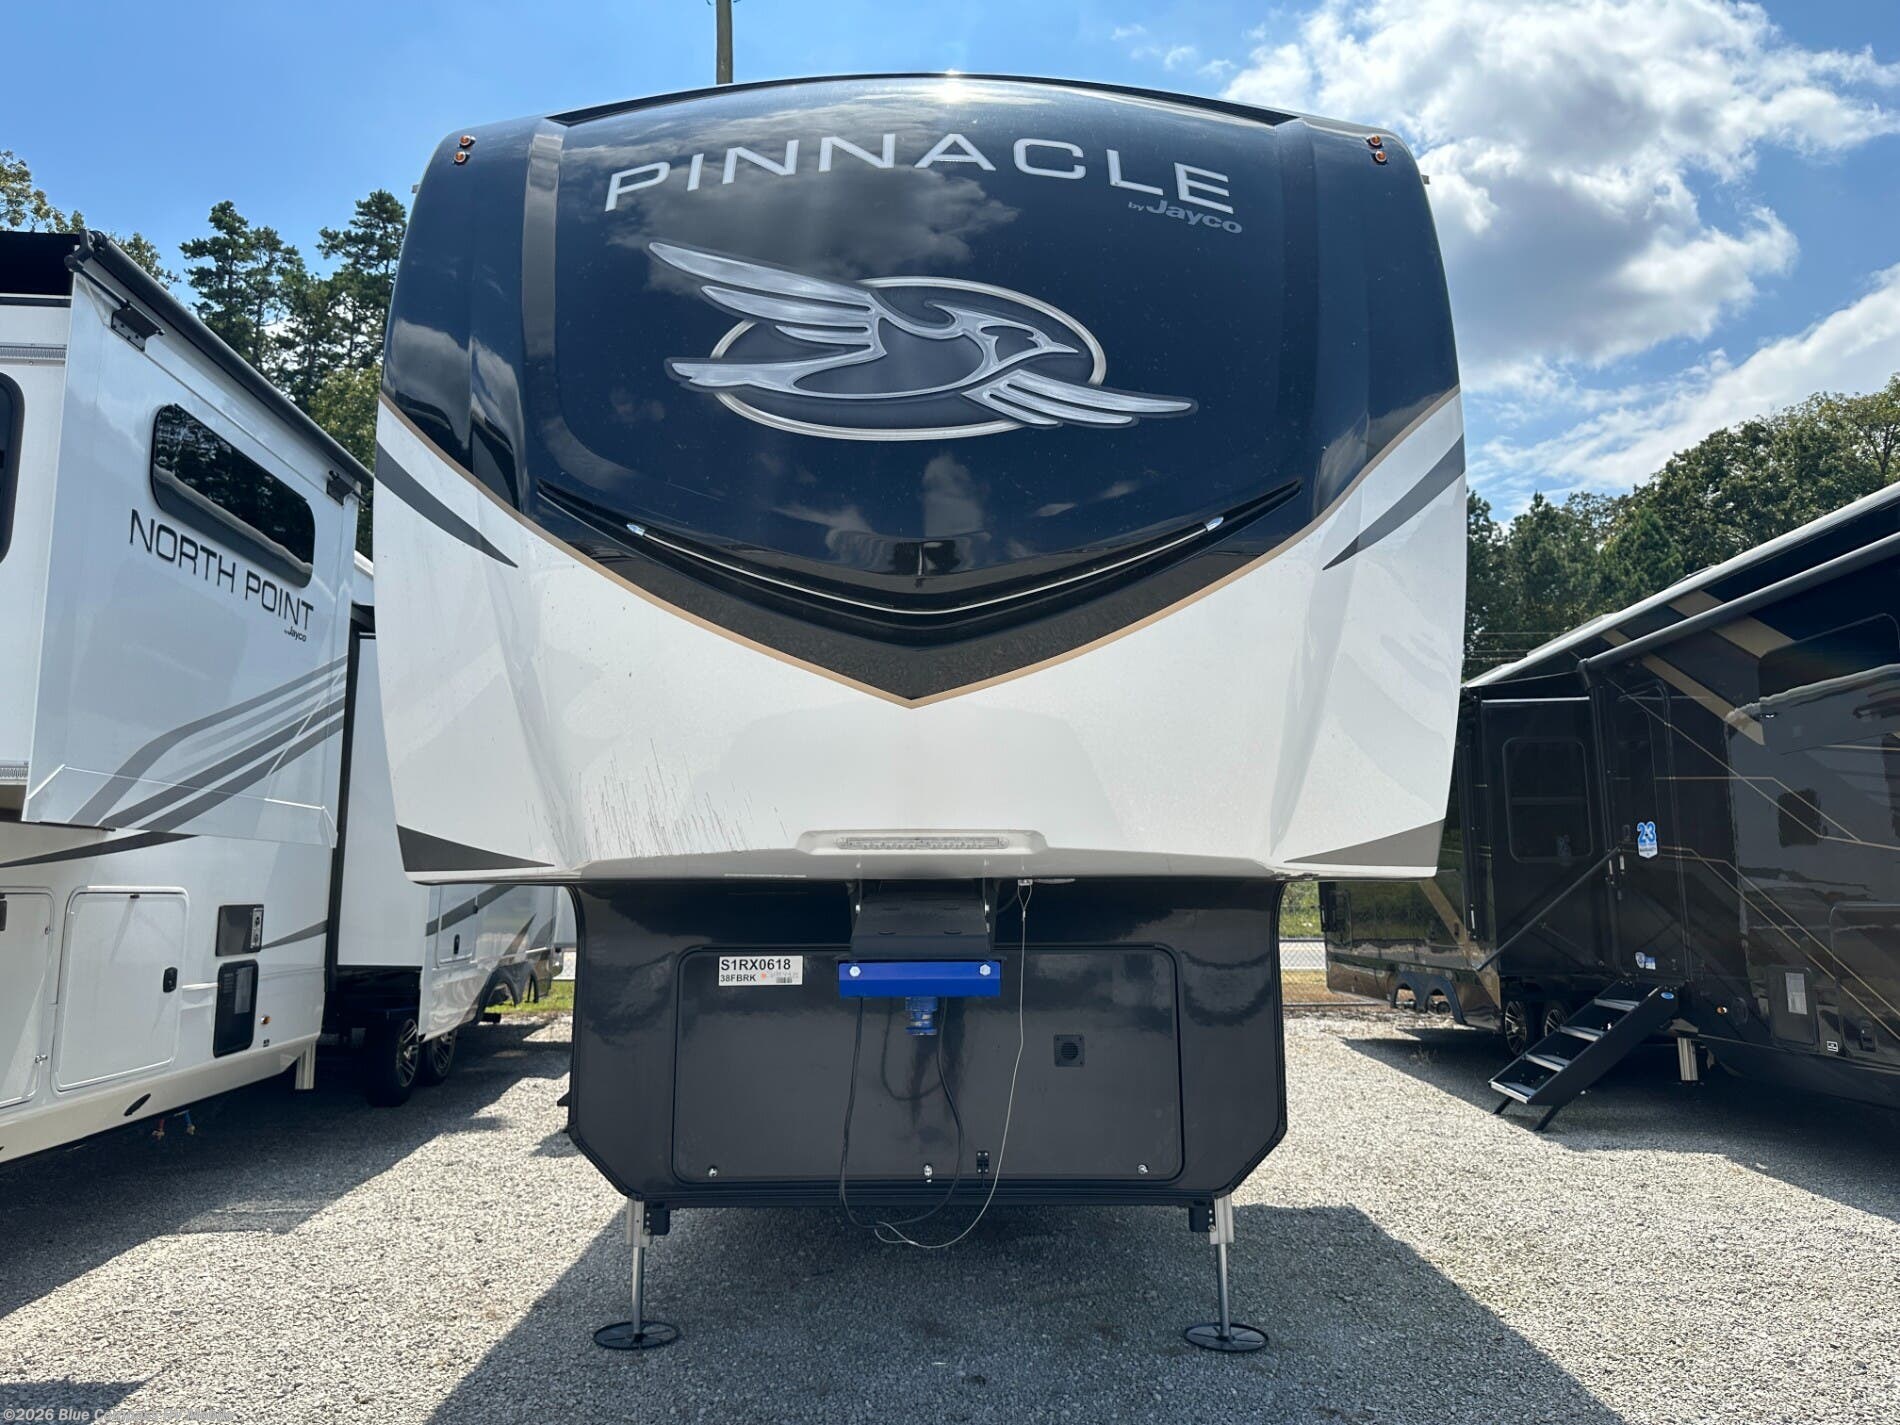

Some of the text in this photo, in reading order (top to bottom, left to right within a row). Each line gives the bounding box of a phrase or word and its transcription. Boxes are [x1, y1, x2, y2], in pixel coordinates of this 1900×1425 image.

[604, 133, 1234, 213] PINNACLE
[1128, 200, 1242, 233] by Jayco
[130, 509, 314, 630] NORTH POINT
[288, 626, 307, 642] Jayco
[721, 959, 791, 971] S1RX0618
[720, 974, 756, 983] 38FBRK
